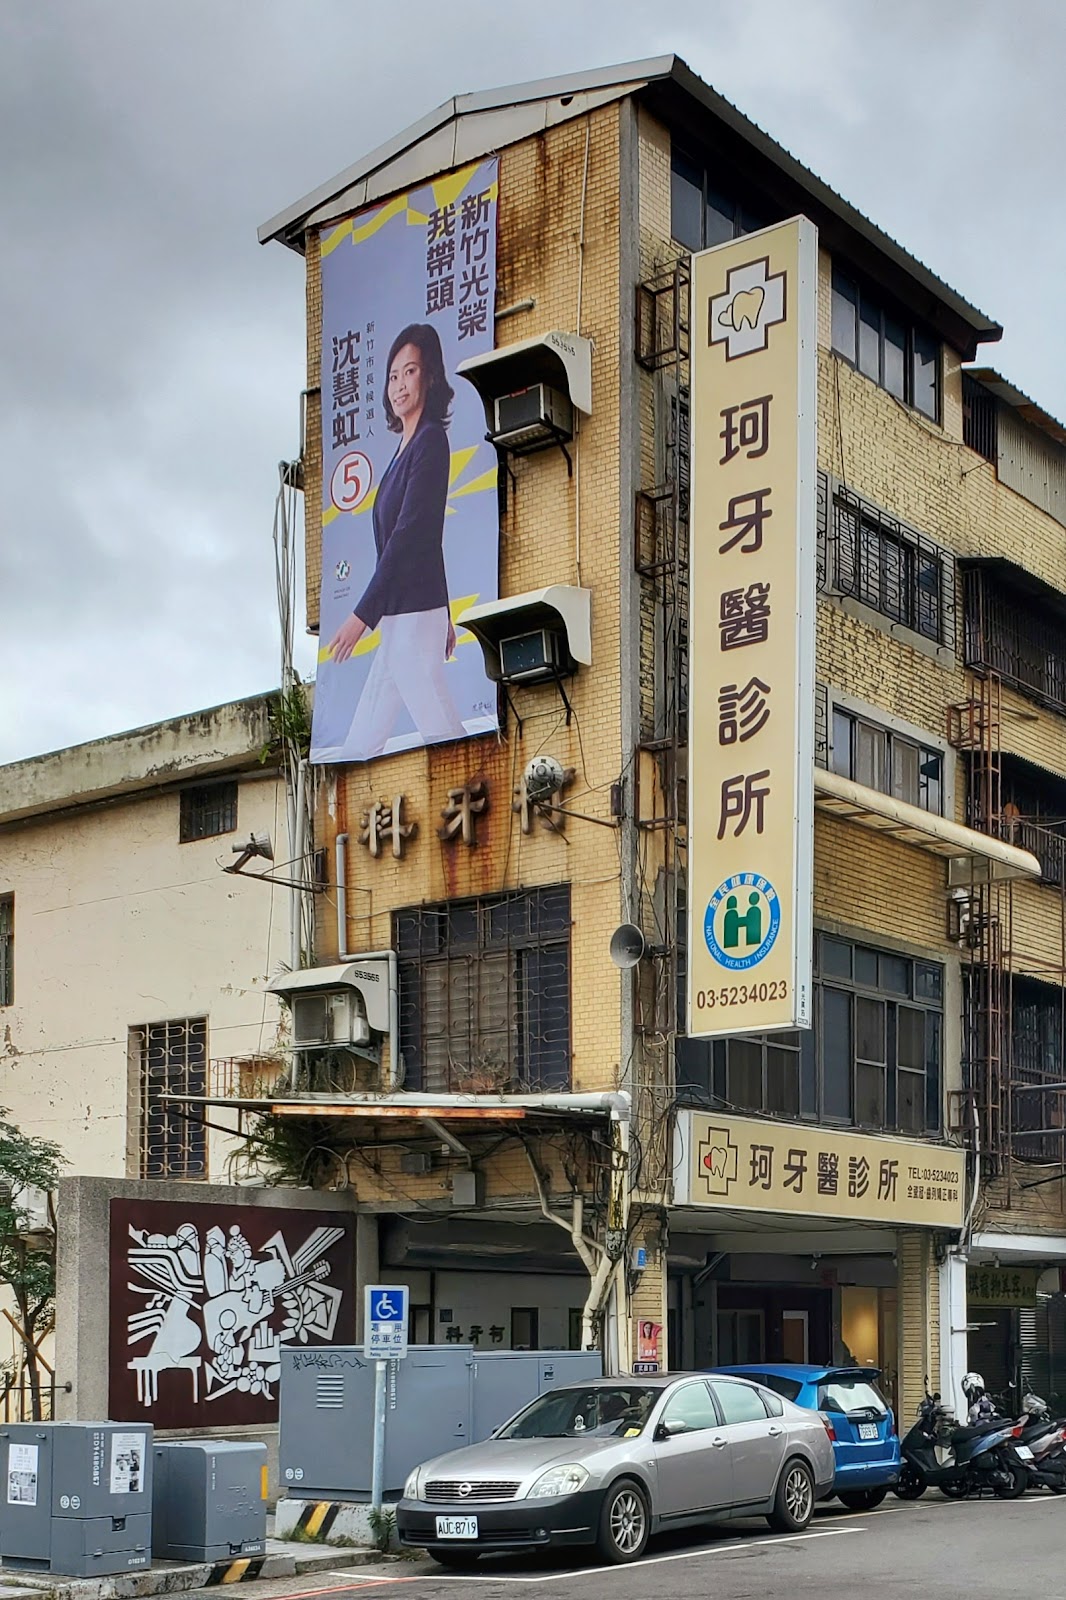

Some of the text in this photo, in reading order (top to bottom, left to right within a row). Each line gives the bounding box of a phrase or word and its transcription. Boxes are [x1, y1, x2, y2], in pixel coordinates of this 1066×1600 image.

[426, 203, 456, 316] 我帶頭
[458, 188, 490, 341] 新竹光榮
[332, 330, 360, 449] 沈慧虹
[366, 321, 375, 438] 新竹市長候選人
[342, 460, 361, 503] 5
[718, 394, 774, 840] 珂牙醫診所
[706, 919, 779, 968] NATIONAL HEALTH INSURANCE
[709, 874, 776, 910] 全民健康保險
[749, 1144, 899, 1201] 珂牙醫診所
